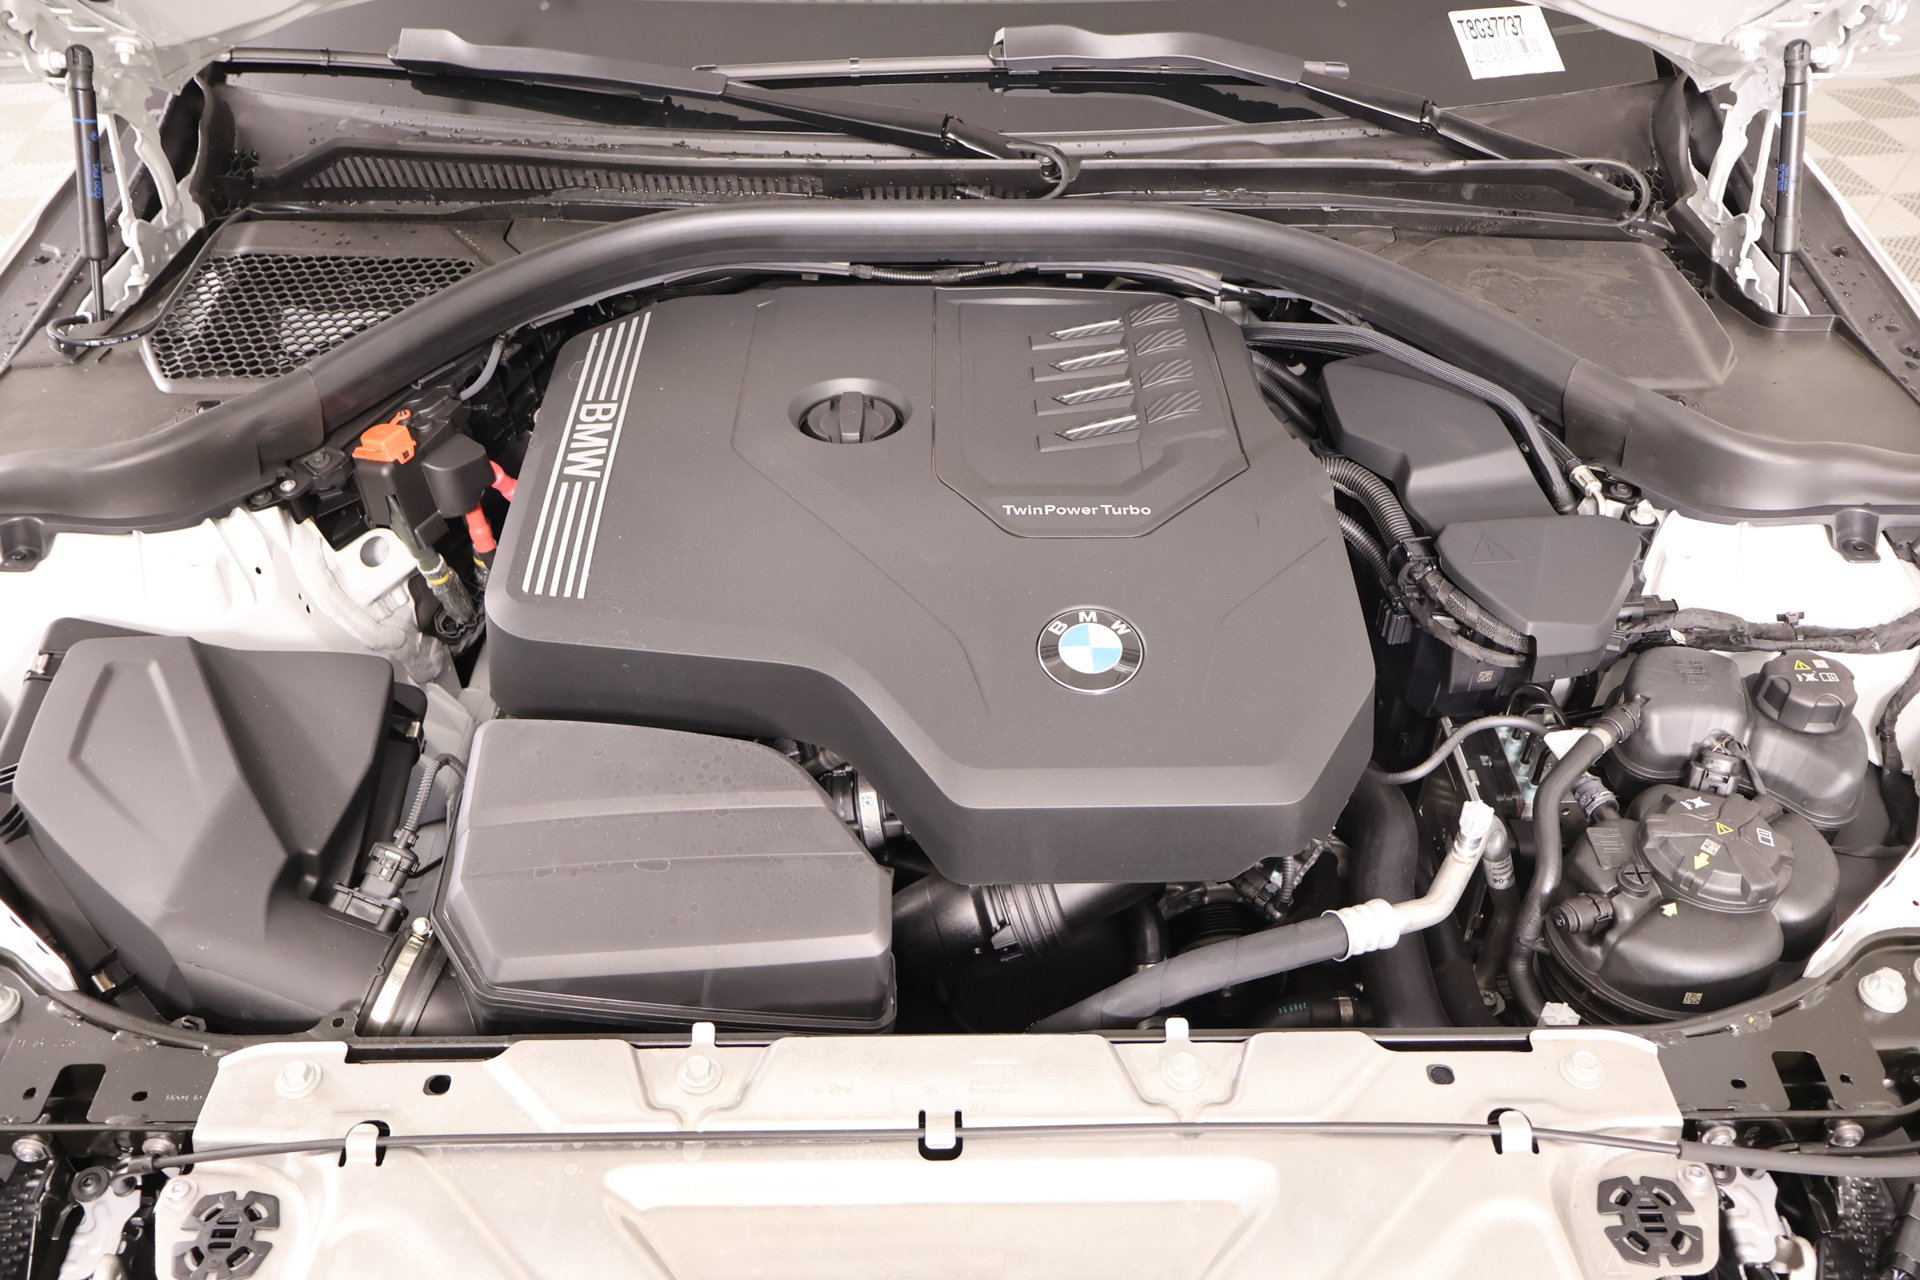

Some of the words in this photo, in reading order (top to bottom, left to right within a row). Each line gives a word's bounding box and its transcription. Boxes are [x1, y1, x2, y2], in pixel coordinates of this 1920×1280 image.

[1457, 15, 1524, 40] T8G37737
[562, 402, 619, 478] BMW
[1100, 504, 1151, 516] Turbo
[1048, 611, 1132, 635] BMW
